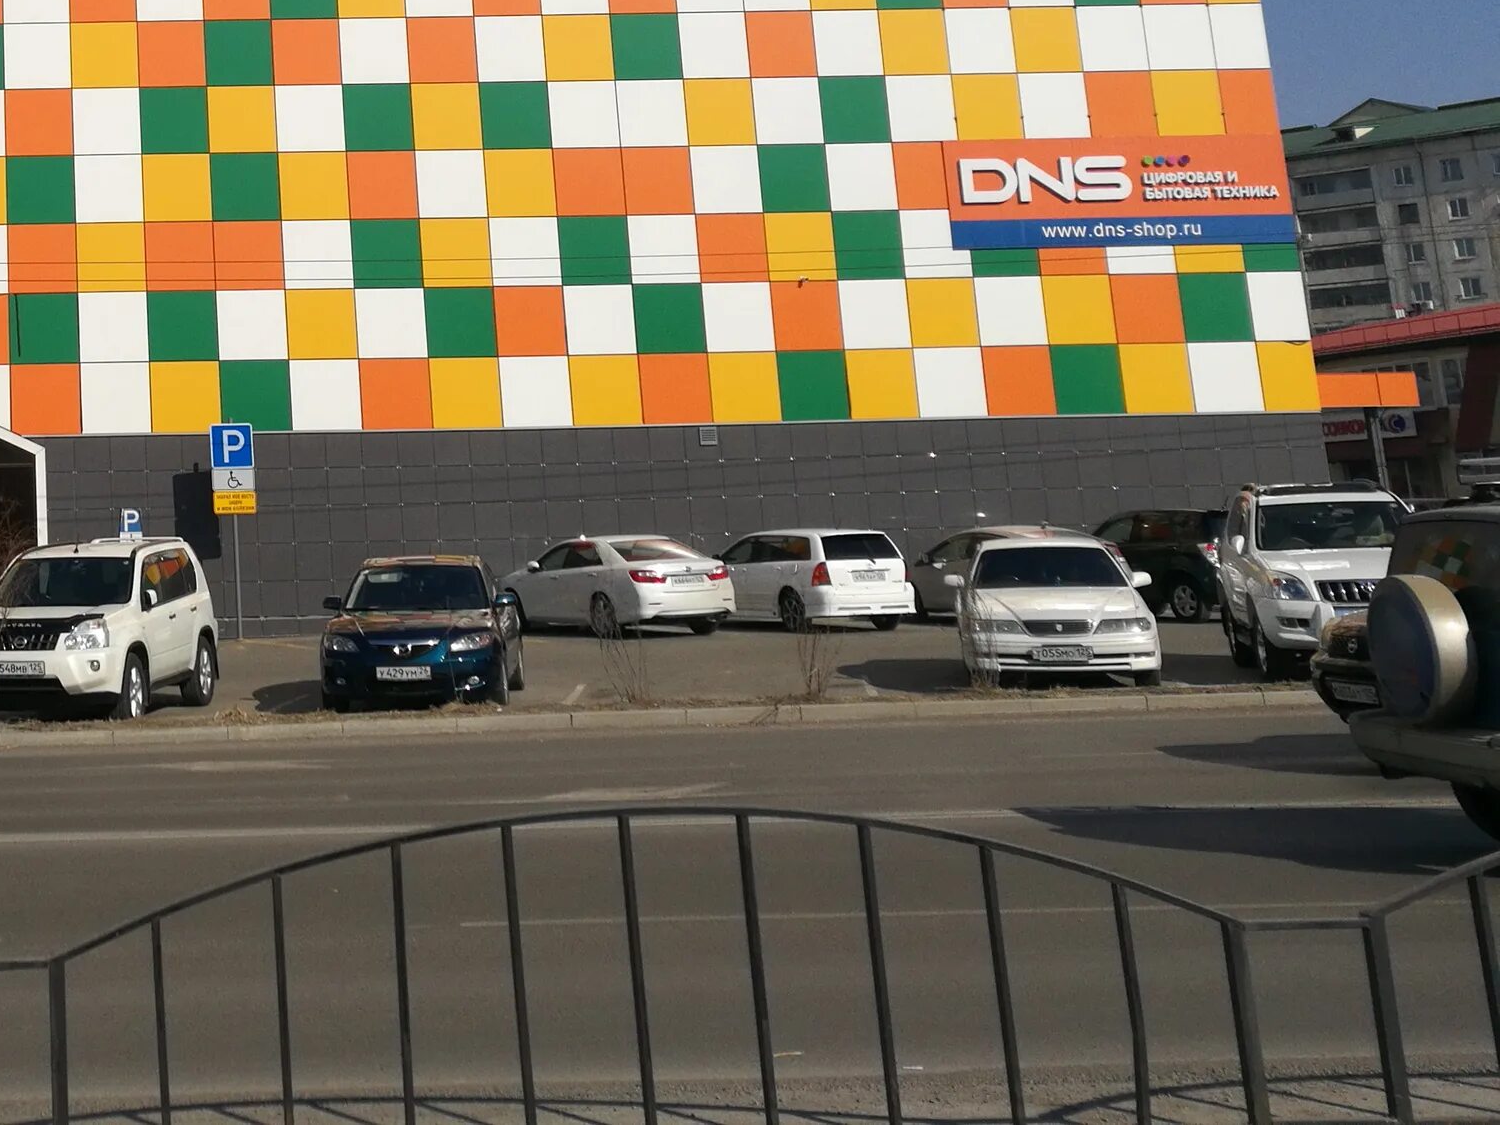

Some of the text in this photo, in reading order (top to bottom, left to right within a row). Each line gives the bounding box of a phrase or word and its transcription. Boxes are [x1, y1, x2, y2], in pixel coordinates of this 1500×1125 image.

[958, 155, 1133, 204] DNS
[1142, 171, 1238, 186] ЦИФРОВАЯ И
[1144, 185, 1280, 201] БЫТОВАЯ ТЕХНИКА
[1041, 223, 1202, 240] www.dns-shop.ru
[222, 429, 245, 464] P
